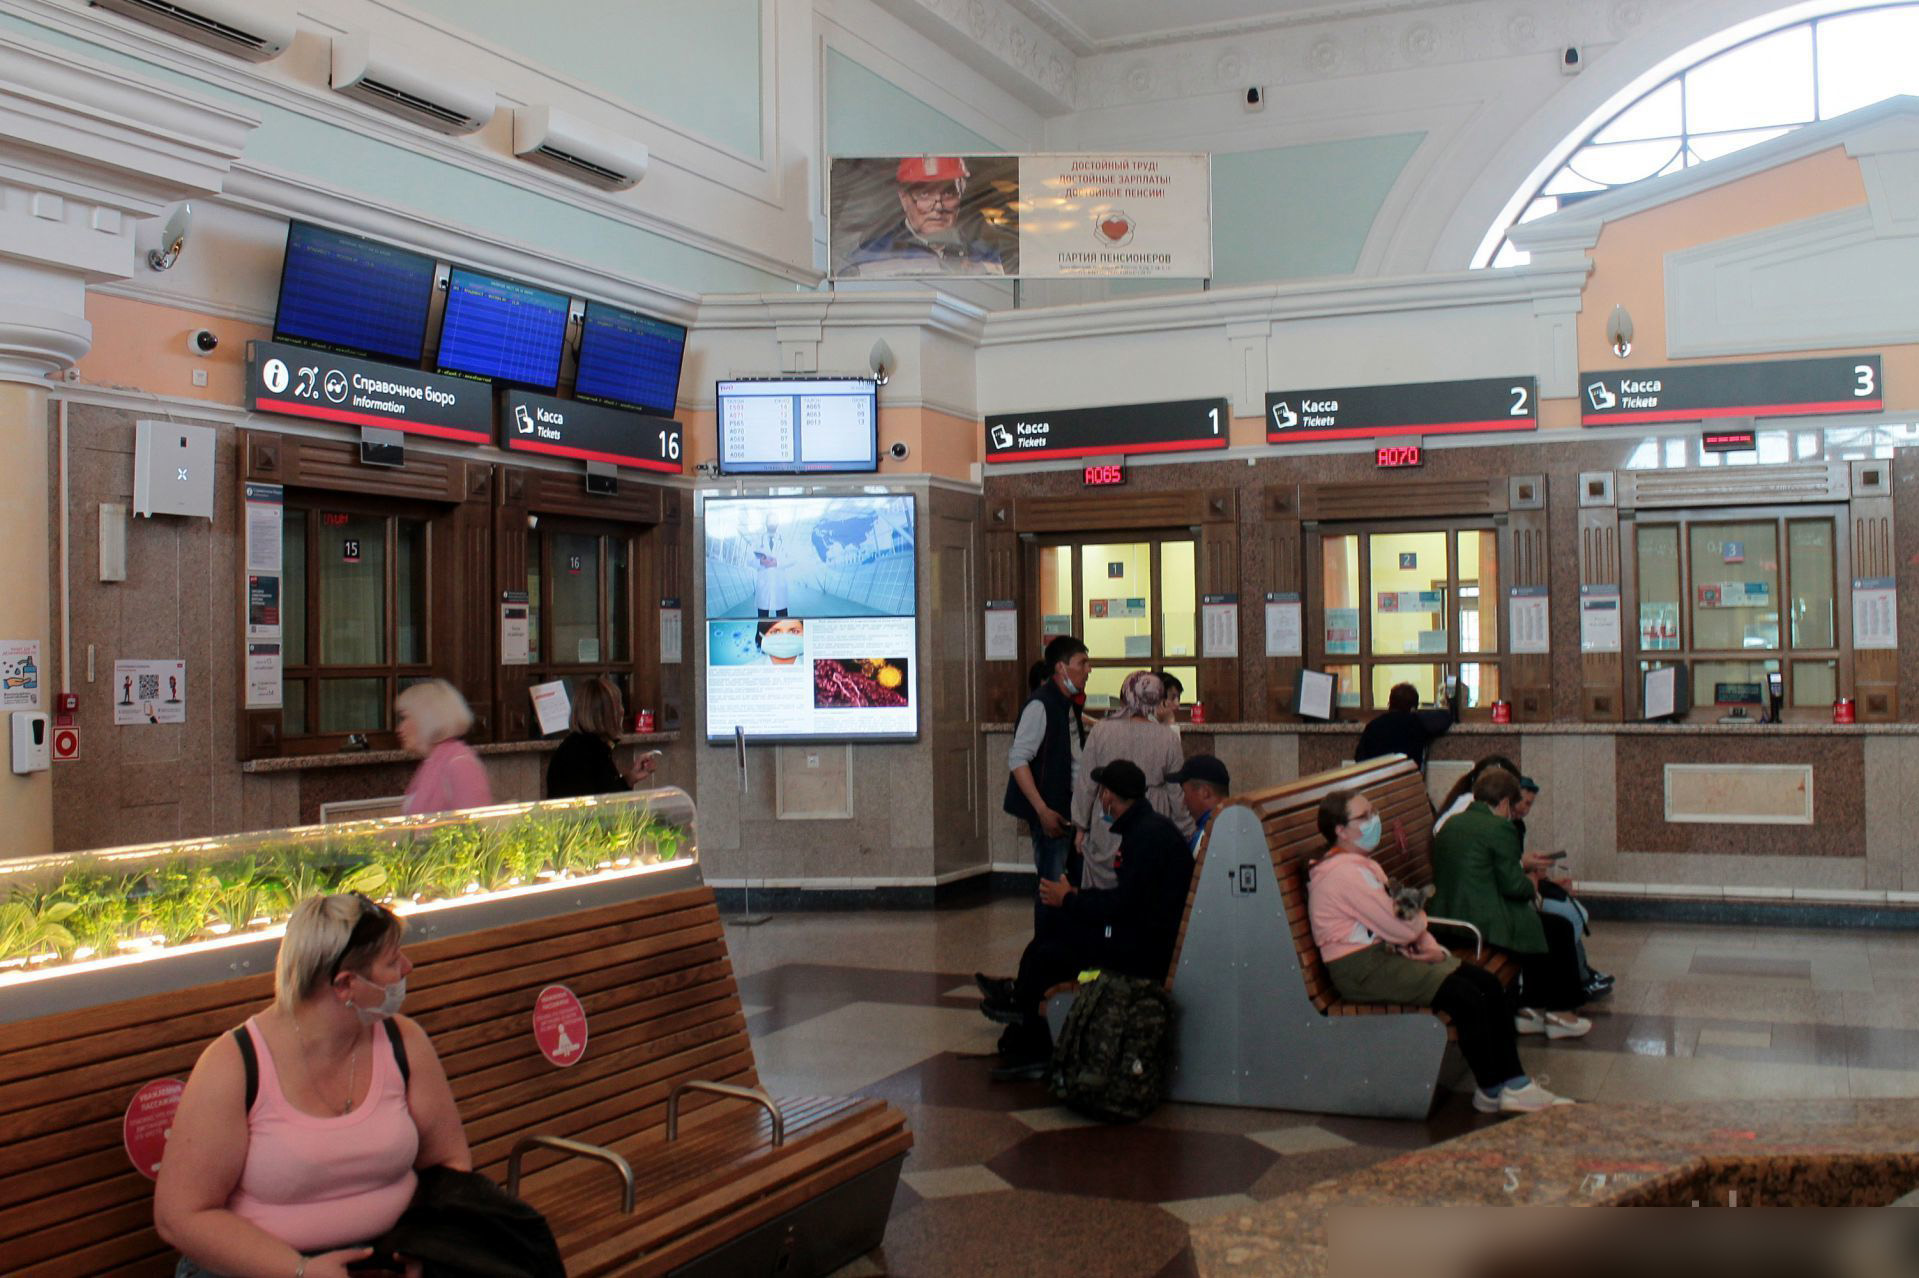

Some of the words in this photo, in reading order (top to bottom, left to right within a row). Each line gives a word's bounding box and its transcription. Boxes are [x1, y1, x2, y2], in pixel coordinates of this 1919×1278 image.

[1072, 160, 1129, 171] ДОСТОЙНЫЙ
[1133, 161, 1159, 172] ТРУД!
[1058, 174, 1115, 185] ДОСТОЙНЫЕ
[1119, 175, 1171, 185] ЗАРПЛАТЫ!
[1065, 188, 1120, 198] ДОСТОЙНЫЕ
[1125, 188, 1165, 198] ПЕНСИИ!
[1058, 252, 1097, 263] ПАРТИЯ
[1100, 253, 1171, 264] ПЕНСИОНЕРОВ
[1621, 380, 1661, 394] Касса
[1853, 365, 1874, 396] 3
[352, 373, 423, 400] Справочное
[425, 385, 456, 407] бюро
[352, 395, 405, 415] Information
[1302, 400, 1338, 414] Касса
[1510, 387, 1528, 415] 2
[1621, 396, 1658, 409] Tickets
[537, 407, 563, 425] Касса
[1208, 408, 1219, 435] 1
[1303, 416, 1335, 428] Tickets
[537, 426, 561, 440] Tickets
[1017, 422, 1050, 436] Касса
[658, 430, 680, 459] 16
[1018, 437, 1047, 448] Tickets
[1378, 446, 1419, 465] A070
[1085, 466, 1121, 484] A065
[345, 542, 358, 556] 15
[570, 557, 580, 568] 16
[1403, 555, 1410, 566] 2
